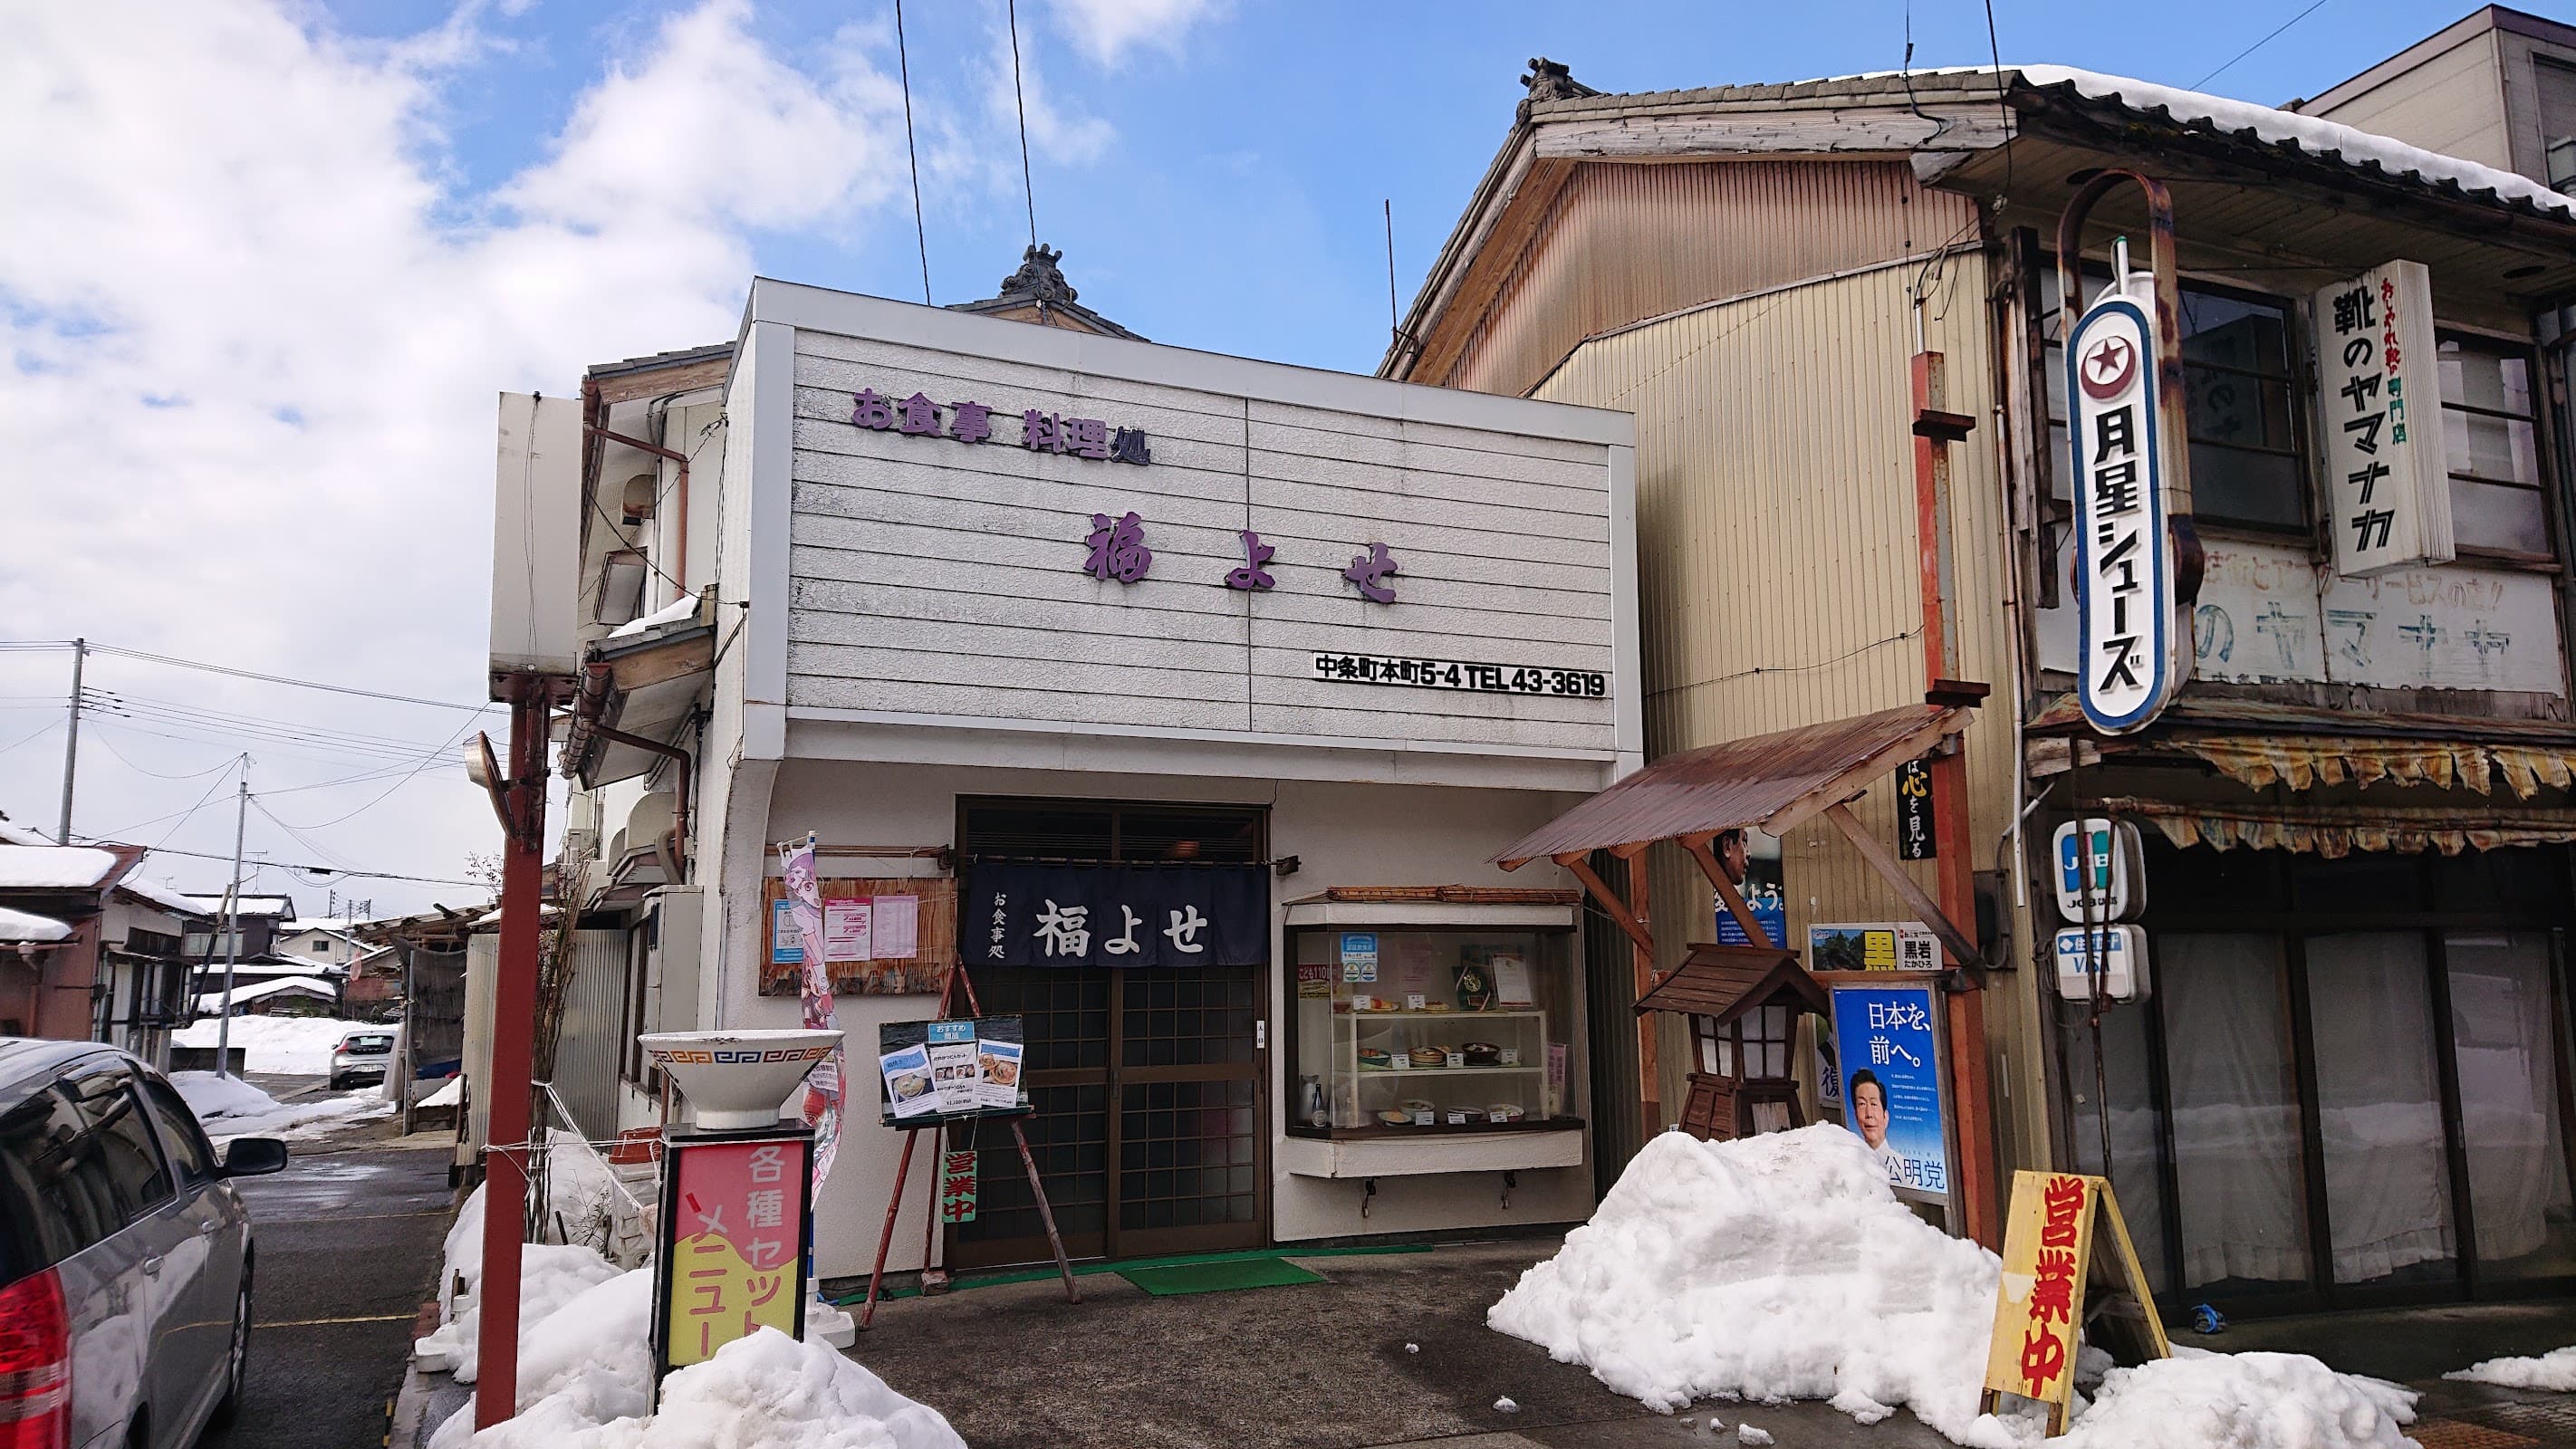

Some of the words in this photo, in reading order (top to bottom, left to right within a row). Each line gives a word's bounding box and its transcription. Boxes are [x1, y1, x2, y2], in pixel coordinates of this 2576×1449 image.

[851, 388, 993, 444] お食事
[1023, 408, 1151, 465] 料理処
[2333, 284, 2395, 552] 靴のヤマナカ
[1083, 511, 1399, 604] 福よせ
[2093, 404, 2143, 694] 月星シューズ
[987, 892, 1007, 960] お食事処
[1033, 898, 1208, 958] 福よせ
[1904, 940, 1932, 960] 黒岩
[1904, 960, 1933, 968] たかひろ
[1869, 1001, 1932, 1032] 日本を、
[1869, 1035, 1921, 1068] 前へ。
[944, 1152, 976, 1221] 営業中
[1885, 1155, 1946, 1190] 公明党
[687, 1195, 728, 1358] メニュー
[2021, 1176, 2085, 1398] 営業中
